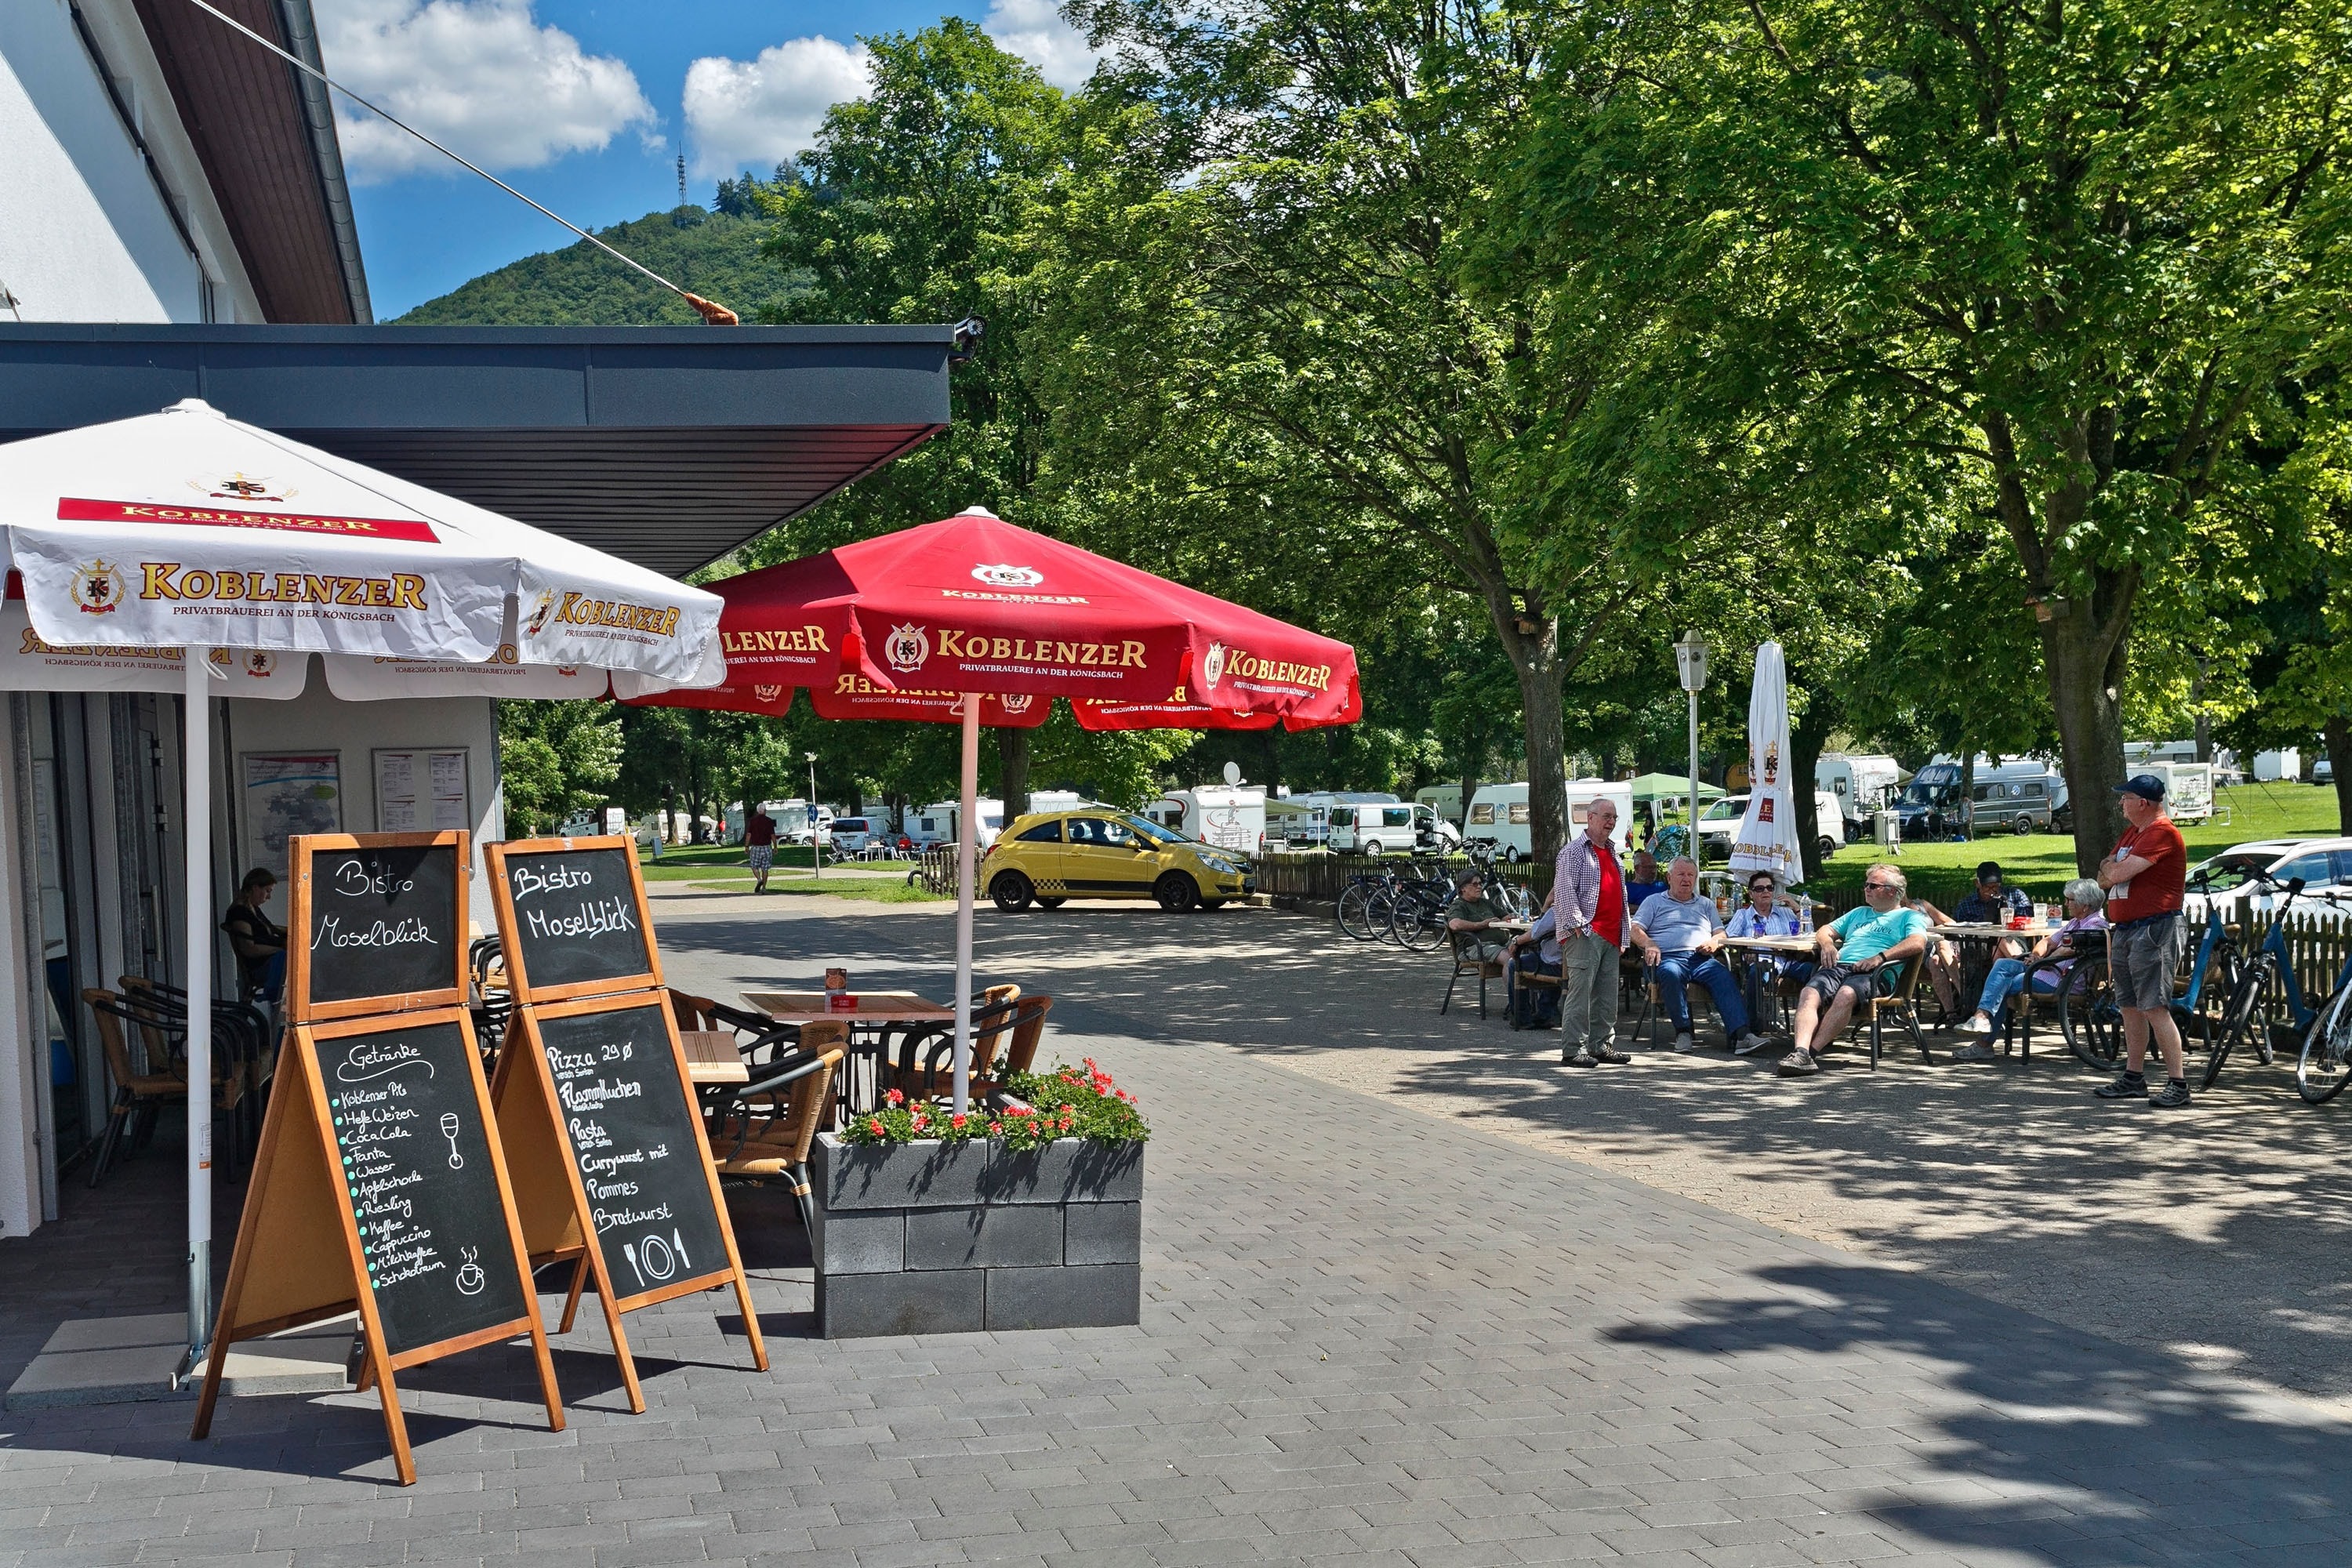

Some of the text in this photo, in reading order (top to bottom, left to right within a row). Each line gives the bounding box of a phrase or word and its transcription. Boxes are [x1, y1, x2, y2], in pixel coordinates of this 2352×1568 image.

[122, 506, 379, 532] KOBLENZER
[140, 562, 428, 611] KOBLENZER
[941, 590, 1091, 604] KOBLENZER
[172, 605, 395, 622] PRIVATBRAUEREI AN DER KÖNIGSBACH
[554, 592, 681, 637] KOBLENZER
[721, 625, 830, 653] LENZER
[936, 630, 1147, 669] KOBLENZER
[724, 656, 747, 665] UEREI
[775, 655, 816, 664] KÖNIGSBACH
[959, 663, 1034, 674] PRIVATBRAUEREI
[1050, 668, 1068, 677] DER
[1069, 668, 1123, 679] KÖNIGSBACH
[1225, 649, 1331, 691] KOBLENZER
[335, 860, 413, 896] Bistro
[514, 864, 592, 901] Bistro
[526, 895, 637, 940] Moselblick
[310, 914, 437, 950] Moselblick
[349, 1044, 421, 1070] Getränke
[546, 1046, 597, 1073] Pizza
[341, 1081, 408, 1109] Koblenzer Pils
[343, 1105, 419, 1134] Hefe Weizen
[569, 1117, 607, 1141] Pasta
[346, 1126, 412, 1145] Coca Cola
[349, 1146, 391, 1163] Fanta
[580, 1143, 670, 1178] Currywurst mit
[356, 1163, 395, 1178] Wasser
[359, 1170, 423, 1204] Apfelschorle
[586, 1178, 639, 1200] Pommes
[361, 1195, 412, 1218] Riesling
[593, 1202, 673, 1235] Bratwurst
[368, 1219, 405, 1242] Kaffee
[372, 1225, 430, 1256] Cappuccino
[376, 1246, 437, 1270] Milchkaffee
[379, 1261, 446, 1287] Schokotraum
